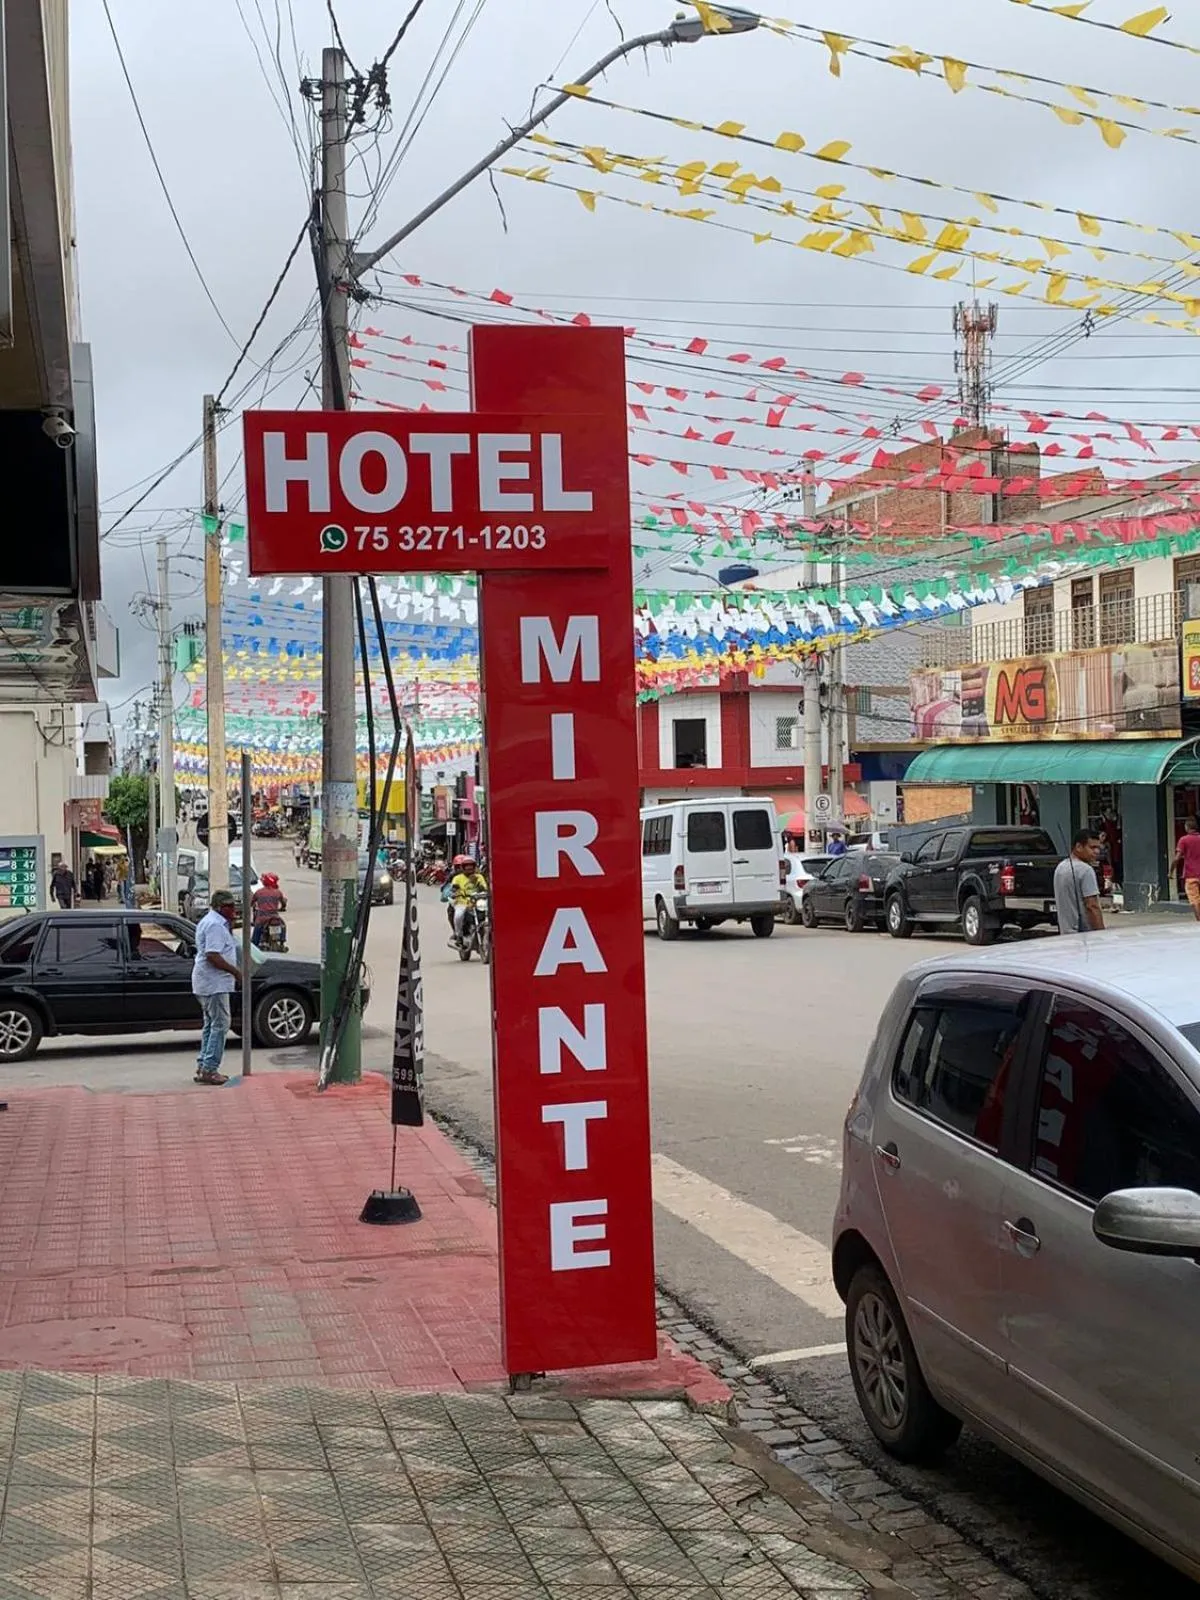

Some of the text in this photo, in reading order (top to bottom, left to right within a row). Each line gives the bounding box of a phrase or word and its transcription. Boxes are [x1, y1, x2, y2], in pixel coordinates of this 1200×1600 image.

[263, 431, 593, 513] HOTEL
[354, 525, 546, 550] 75 3271-1203
[994, 666, 1047, 725] MG
[520, 616, 611, 1272] MIRANTE
